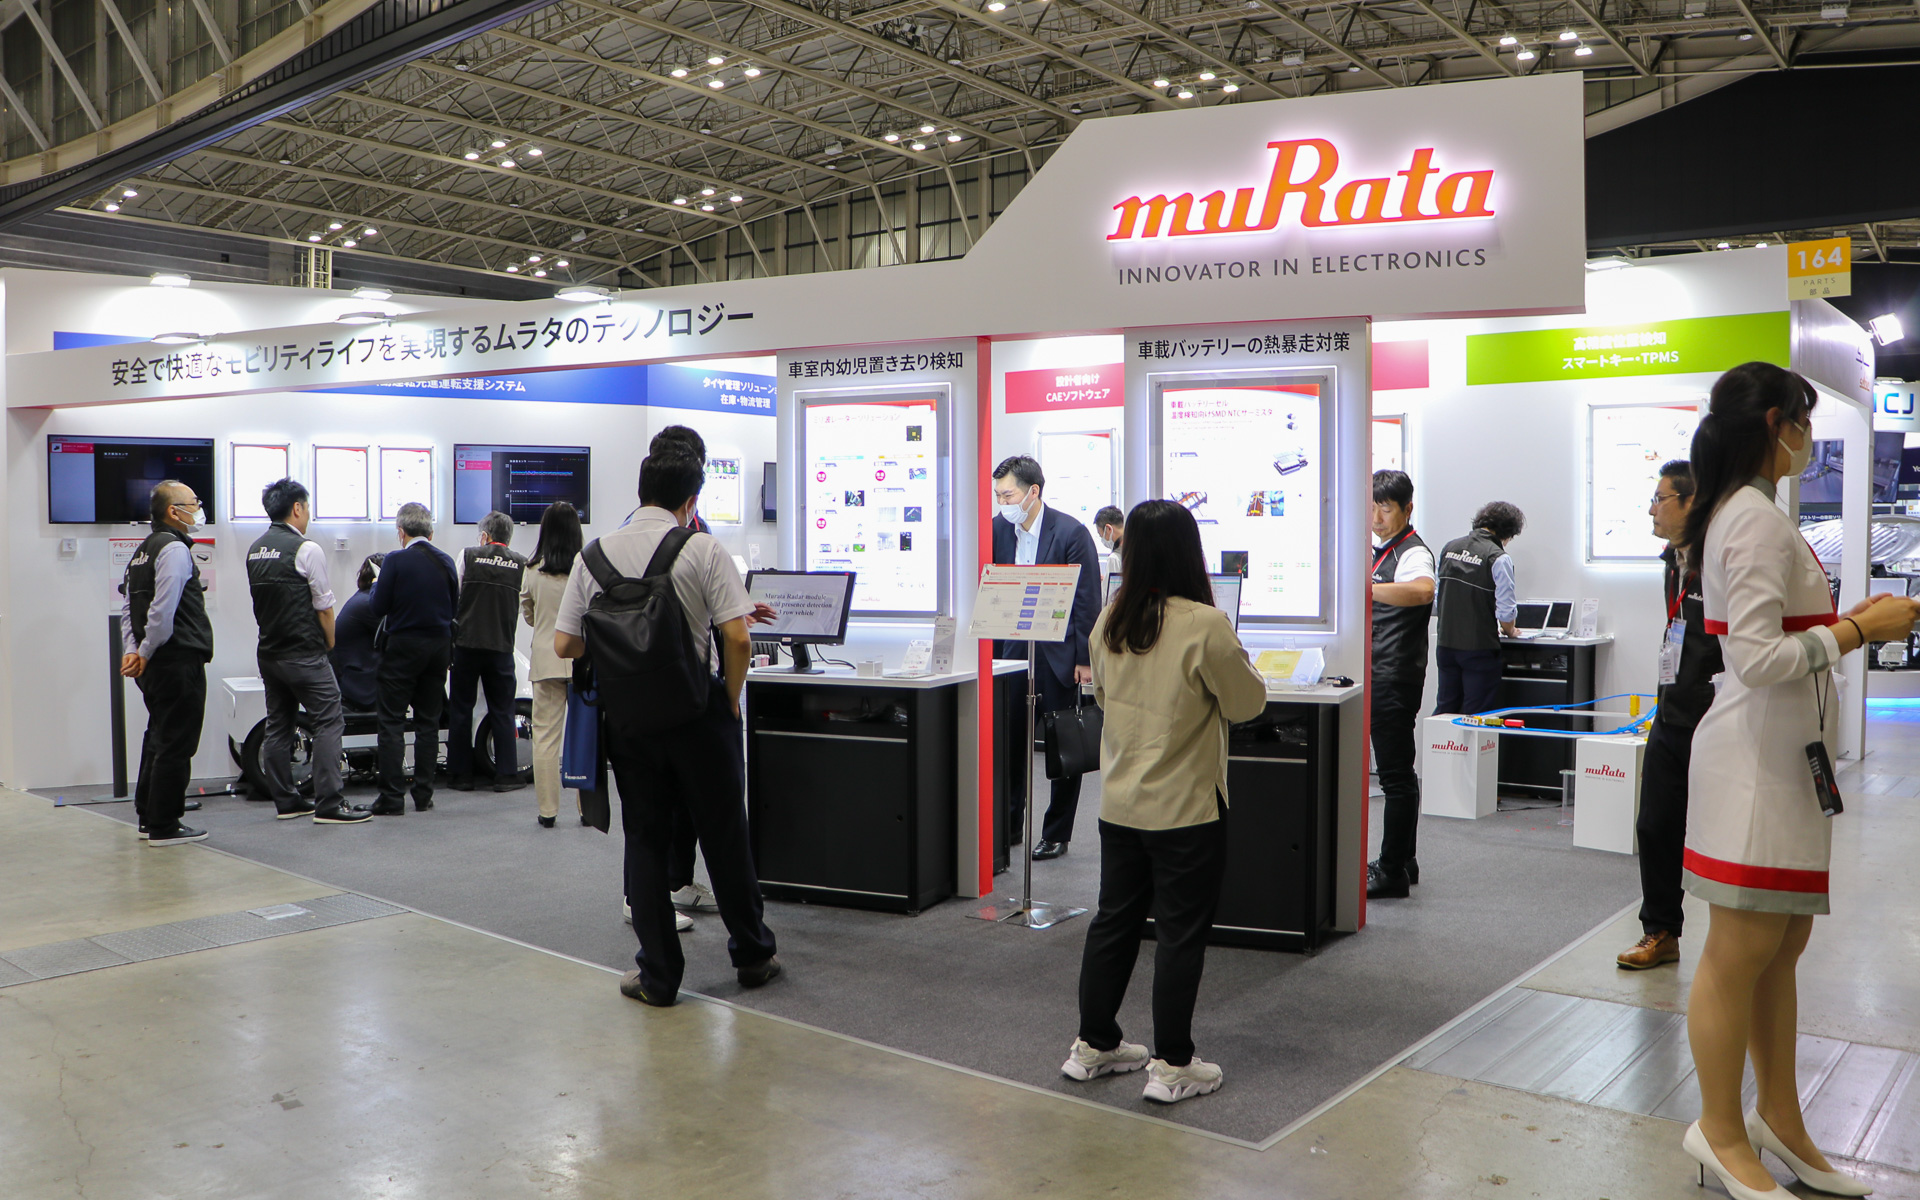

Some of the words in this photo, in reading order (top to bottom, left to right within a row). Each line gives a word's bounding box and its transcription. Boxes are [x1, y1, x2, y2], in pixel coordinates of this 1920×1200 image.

[1106, 138, 1495, 240] muRata
[1797, 246, 1843, 269] 164
[1119, 261, 1260, 285] INNOVATOR
[1273, 258, 1299, 277] IN
[1312, 248, 1487, 274] ELECTRONICS
[1803, 277, 1836, 286] PARTS
[112, 302, 754, 386] 安全で快適なモビリティライフを実現するムラタのテクノロジー
[1138, 332, 1351, 360] 車載バッテリーの熱暴走対策
[788, 351, 964, 379] 車室内幼児置き去り検知
[1562, 351, 1680, 369] スマートキー・TPMS
[1055, 373, 1101, 387] 設計者向け
[720, 393, 771, 409] 在庫・物流管理
[1045, 388, 1111, 403] CAEソフトウェア
[248, 546, 281, 560] muRata
[1444, 549, 1483, 566] muRata
[474, 555, 518, 570] muRata
[1431, 740, 1470, 753] muRata
[1584, 764, 1626, 779] muRata
